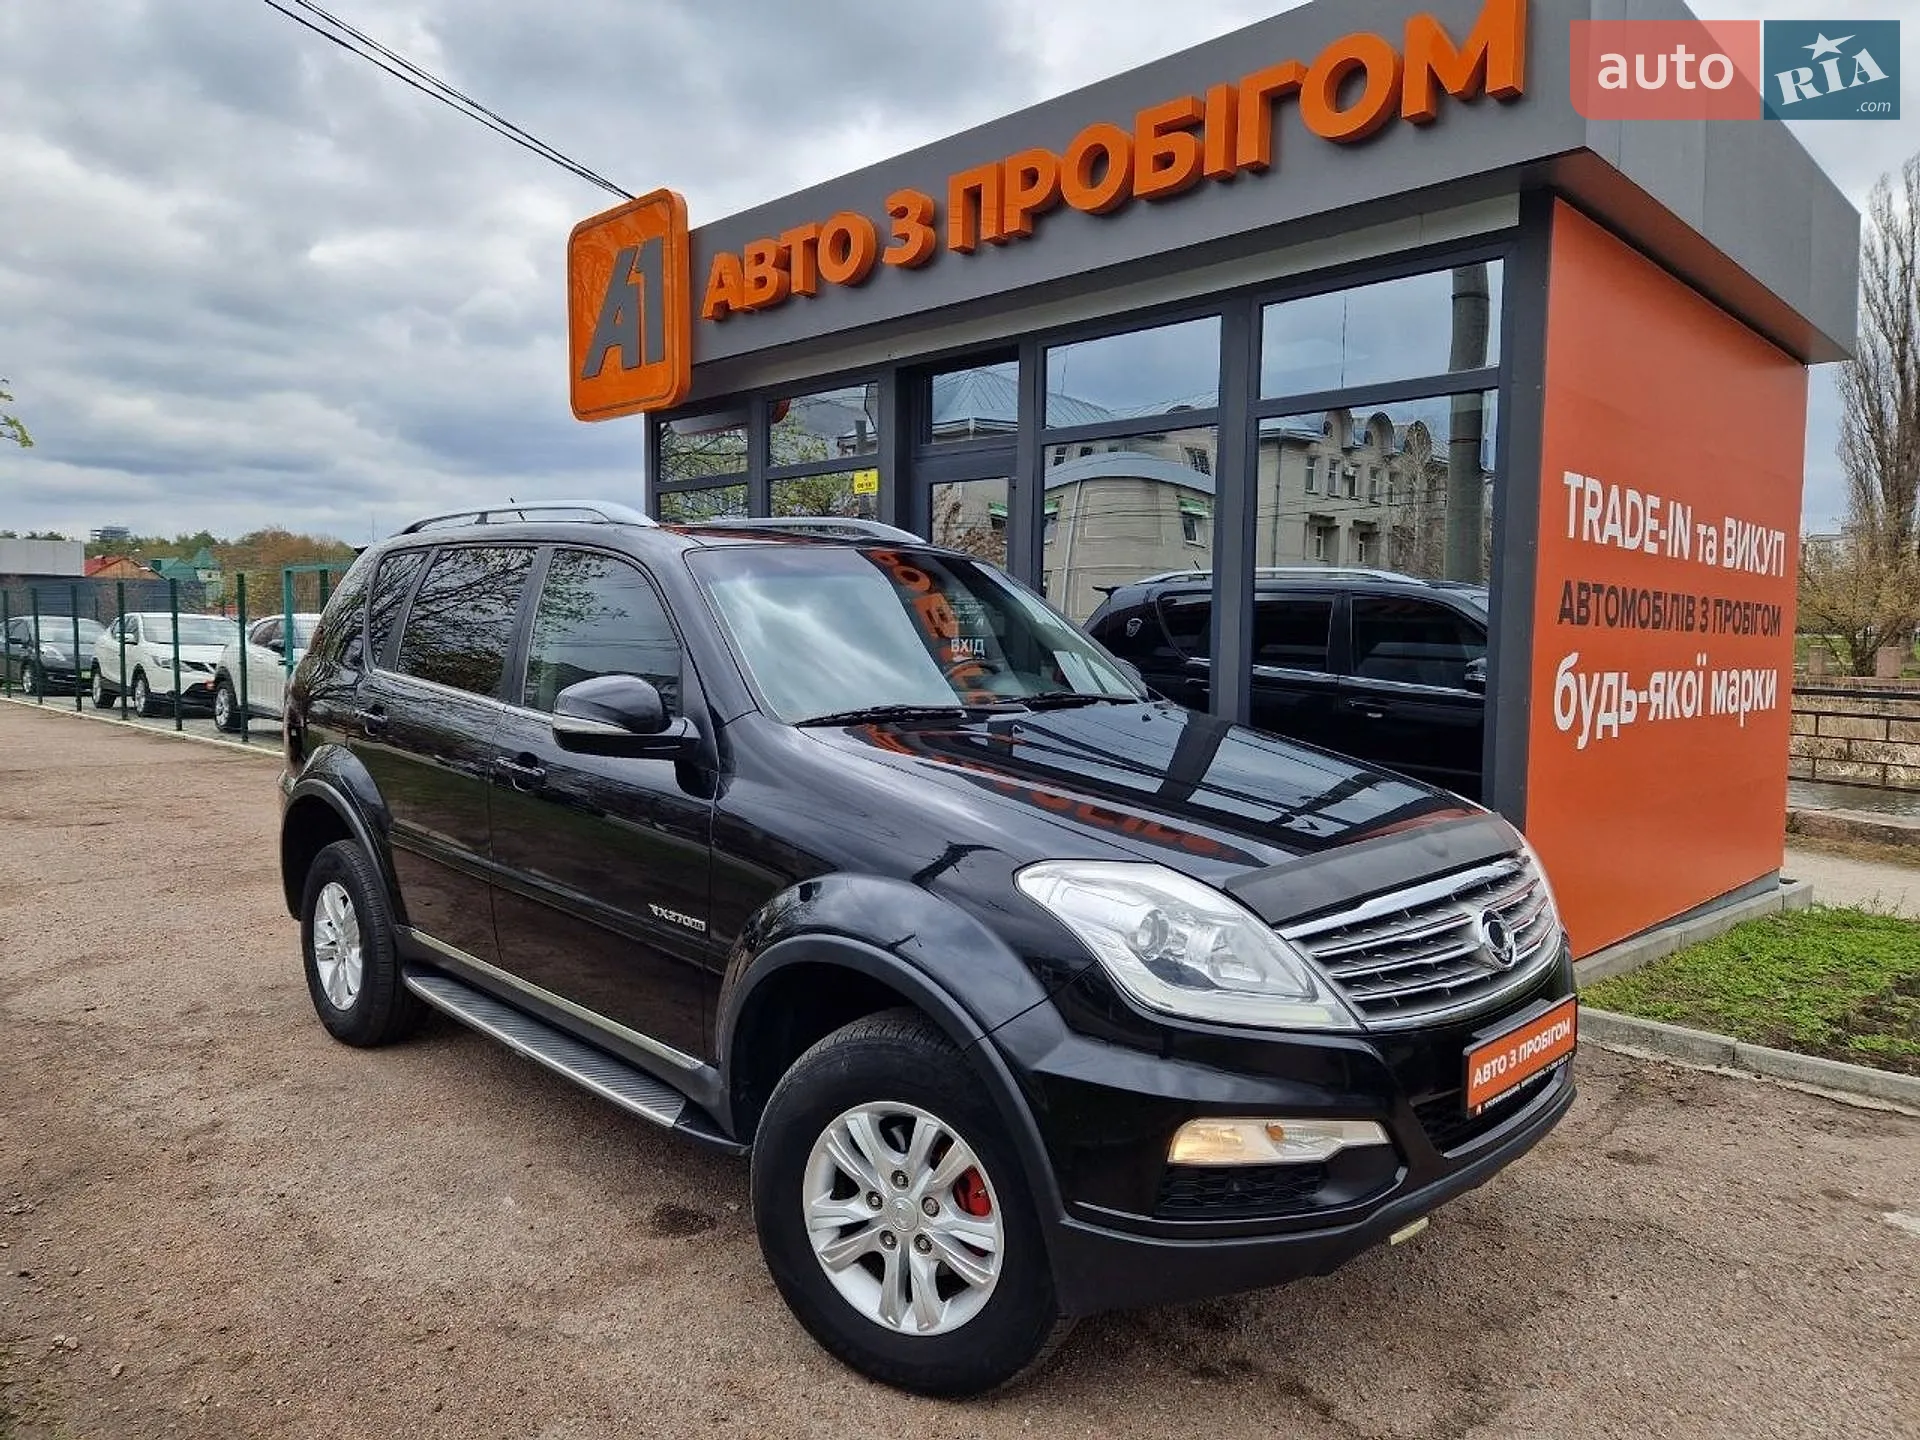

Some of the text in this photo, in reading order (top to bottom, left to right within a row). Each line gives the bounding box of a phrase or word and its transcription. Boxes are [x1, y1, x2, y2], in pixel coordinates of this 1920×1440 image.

[702, 0, 1527, 321] АВТО З ПРОБІГОМ
[1563, 471, 1785, 577] TRADE-IN та ВИКУП
[951, 638, 985, 656] ВХІД
[1557, 580, 1695, 632] АВТОМОБІЛІВ
[1713, 599, 1781, 636] ПРОБІГОМ
[1554, 652, 1777, 750] будь-якої марки
[1474, 1055, 1507, 1086] АВТО
[1519, 1019, 1571, 1062] ПРОБІГОМ
